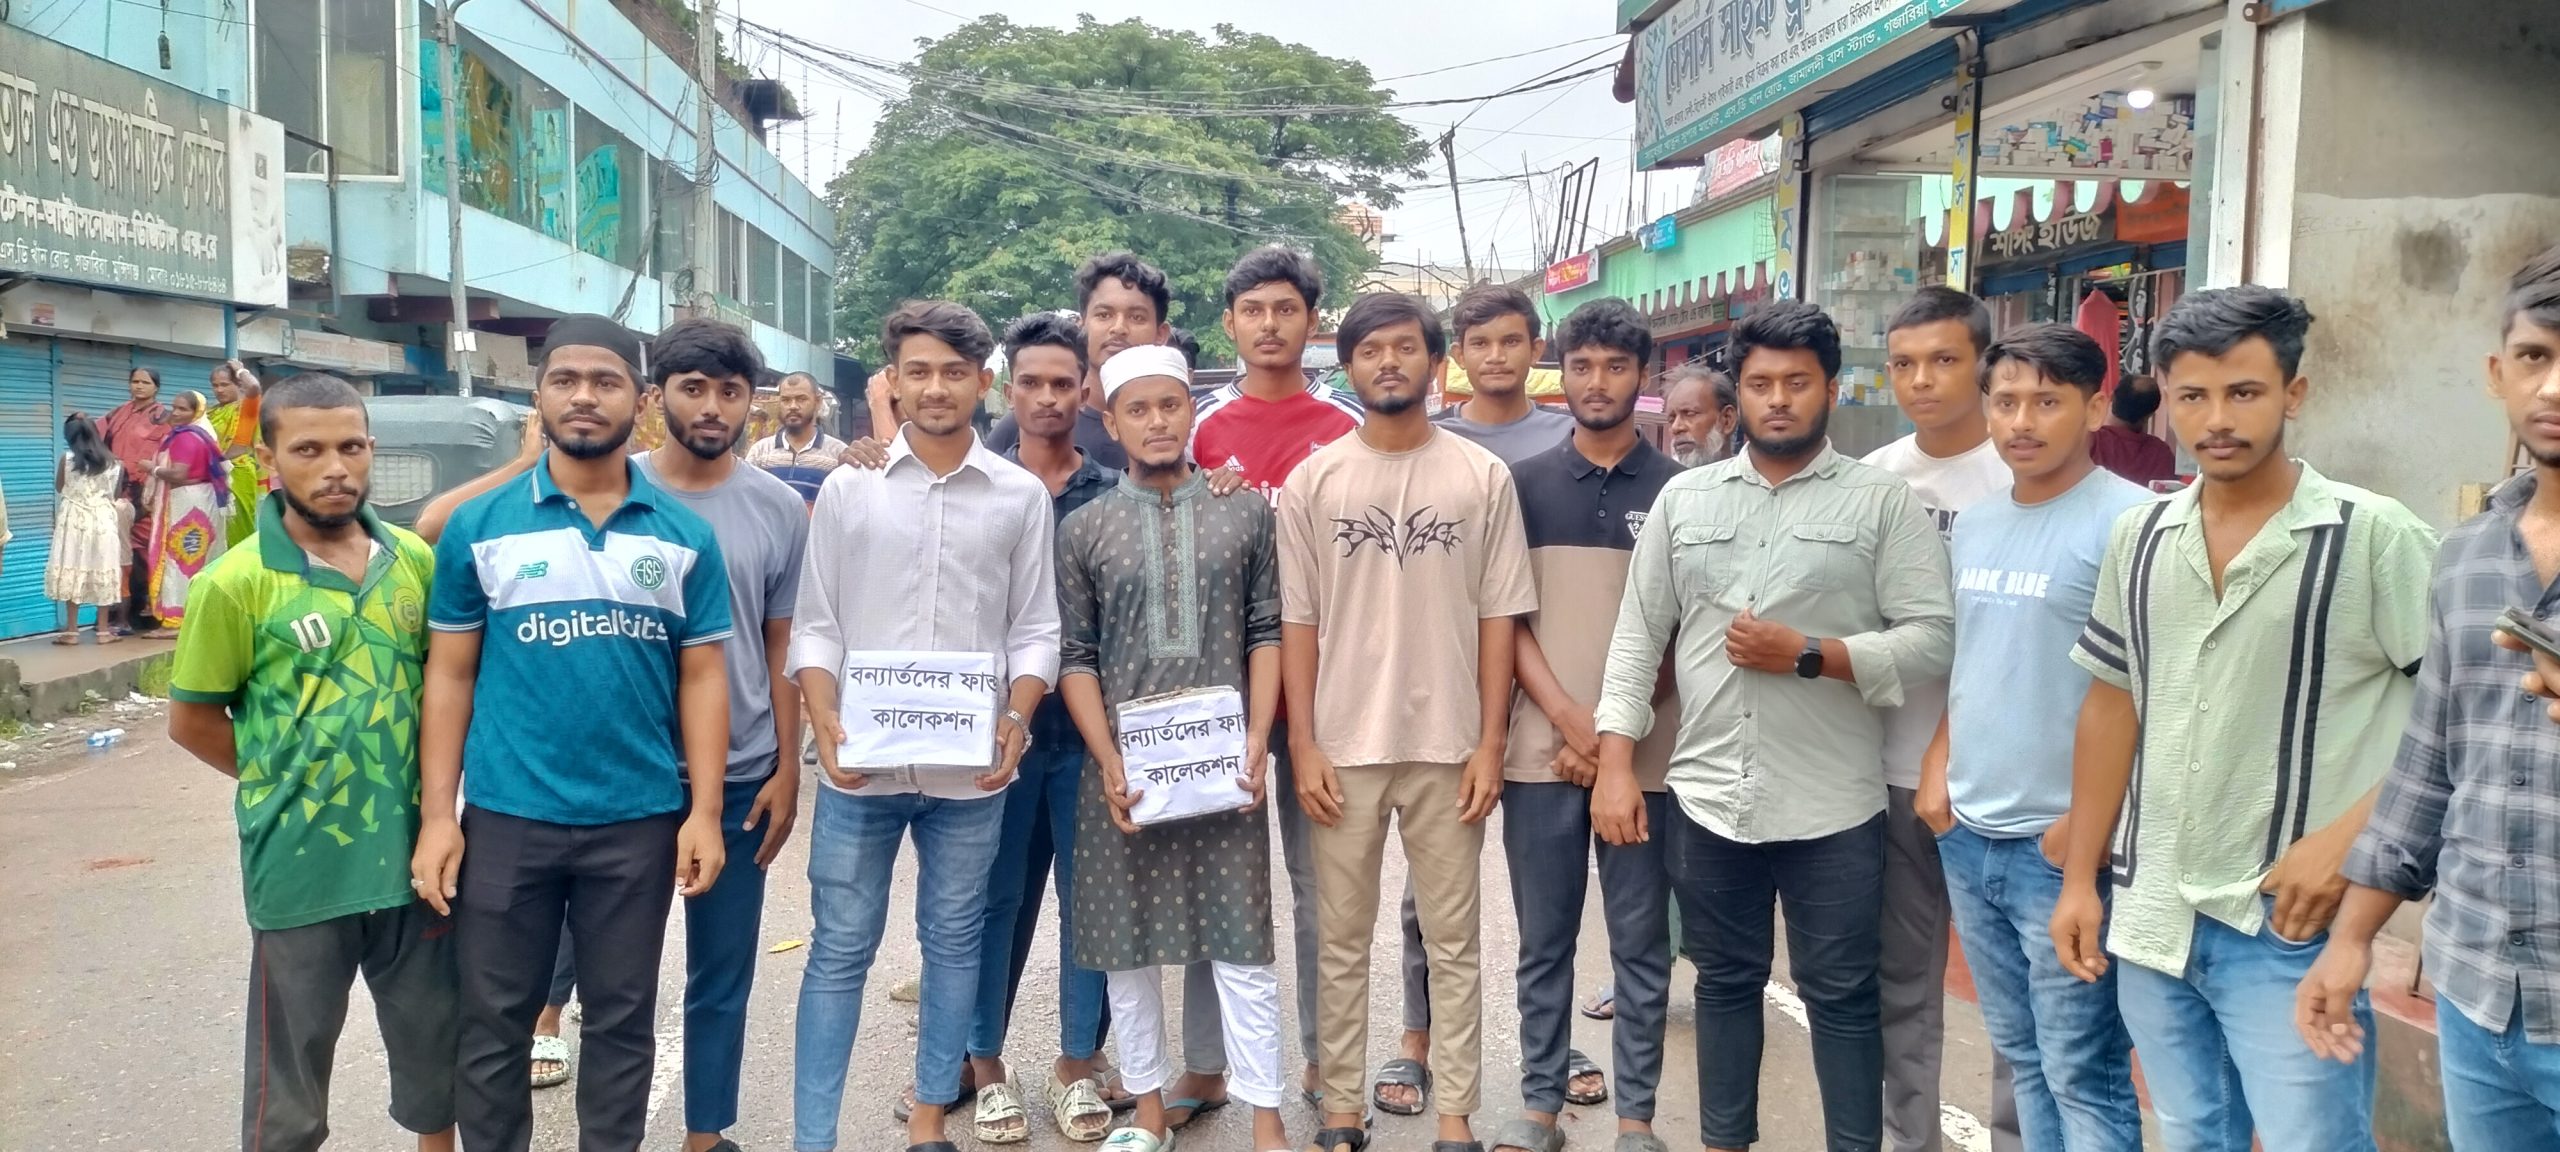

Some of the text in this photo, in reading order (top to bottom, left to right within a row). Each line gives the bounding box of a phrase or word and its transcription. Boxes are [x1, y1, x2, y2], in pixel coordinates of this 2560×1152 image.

[1788, 57, 1824, 84] জামালদী
[1827, 47, 1844, 63] বাস
[2037, 205, 2102, 249] হাউজ
[1957, 567, 2050, 598] DARK BLUE
[290, 612, 332, 654] 10
[517, 609, 669, 646] digitalbits
[849, 661, 953, 689] বন্যার্তদের
[871, 707, 977, 732] কালেকশন
[1120, 712, 1245, 749] বন্যার্তদের ফা
[1143, 755, 1240, 785] কালেকশন
